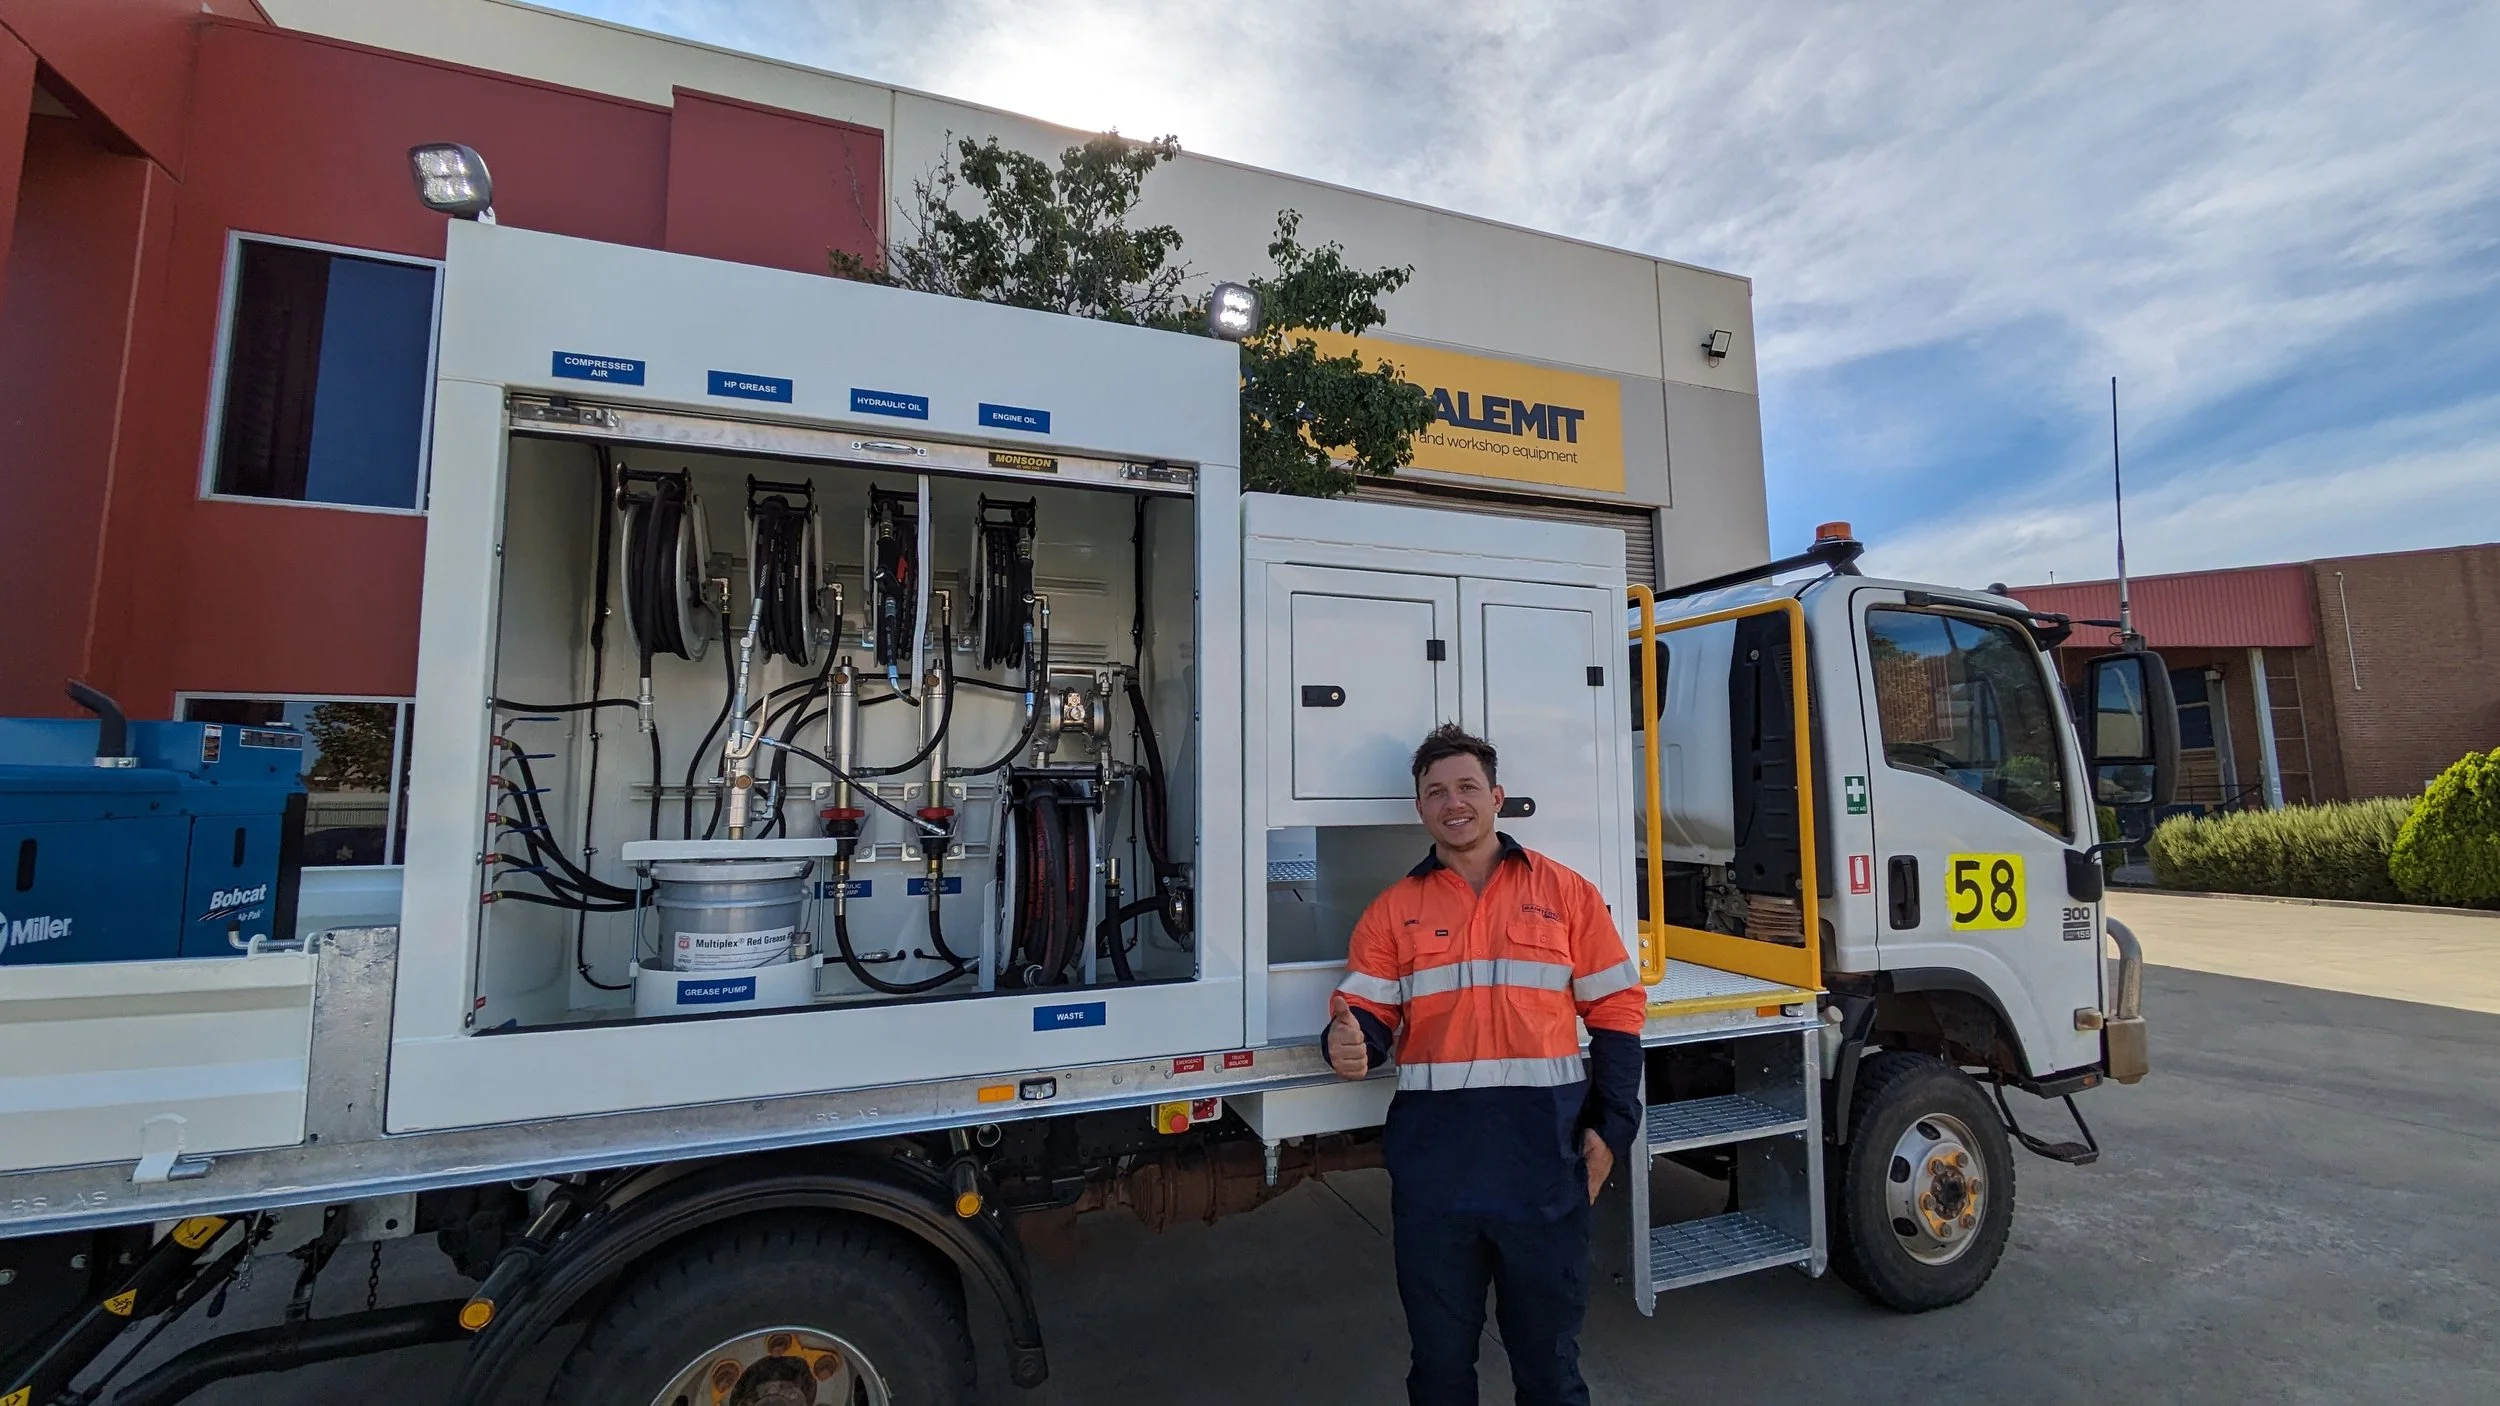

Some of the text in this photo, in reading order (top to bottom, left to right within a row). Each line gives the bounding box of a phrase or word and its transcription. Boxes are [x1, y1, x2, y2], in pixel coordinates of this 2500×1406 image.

[564, 356, 634, 372] COMPRESSED
[590, 369, 608, 378] AIR
[724, 380, 777, 394] HP GREASE
[857, 396, 922, 412] HYDRAULIC OIL
[992, 412, 1037, 425] ENGINE OIL
[1419, 433, 1444, 446] and
[1447, 437, 1510, 456] workshop
[1512, 445, 1579, 464] equipment
[995, 454, 1052, 468] MONSOON
[210, 884, 267, 910] Bobcat
[1955, 859, 2017, 924] 58
[2062, 907, 2090, 921] 300
[10, 915, 72, 946] Miller
[747, 936, 762, 946] Red
[764, 935, 786, 945] Grease
[684, 985, 748, 997] GREASE PUMP
[1056, 1011, 1084, 1021] WASTE
